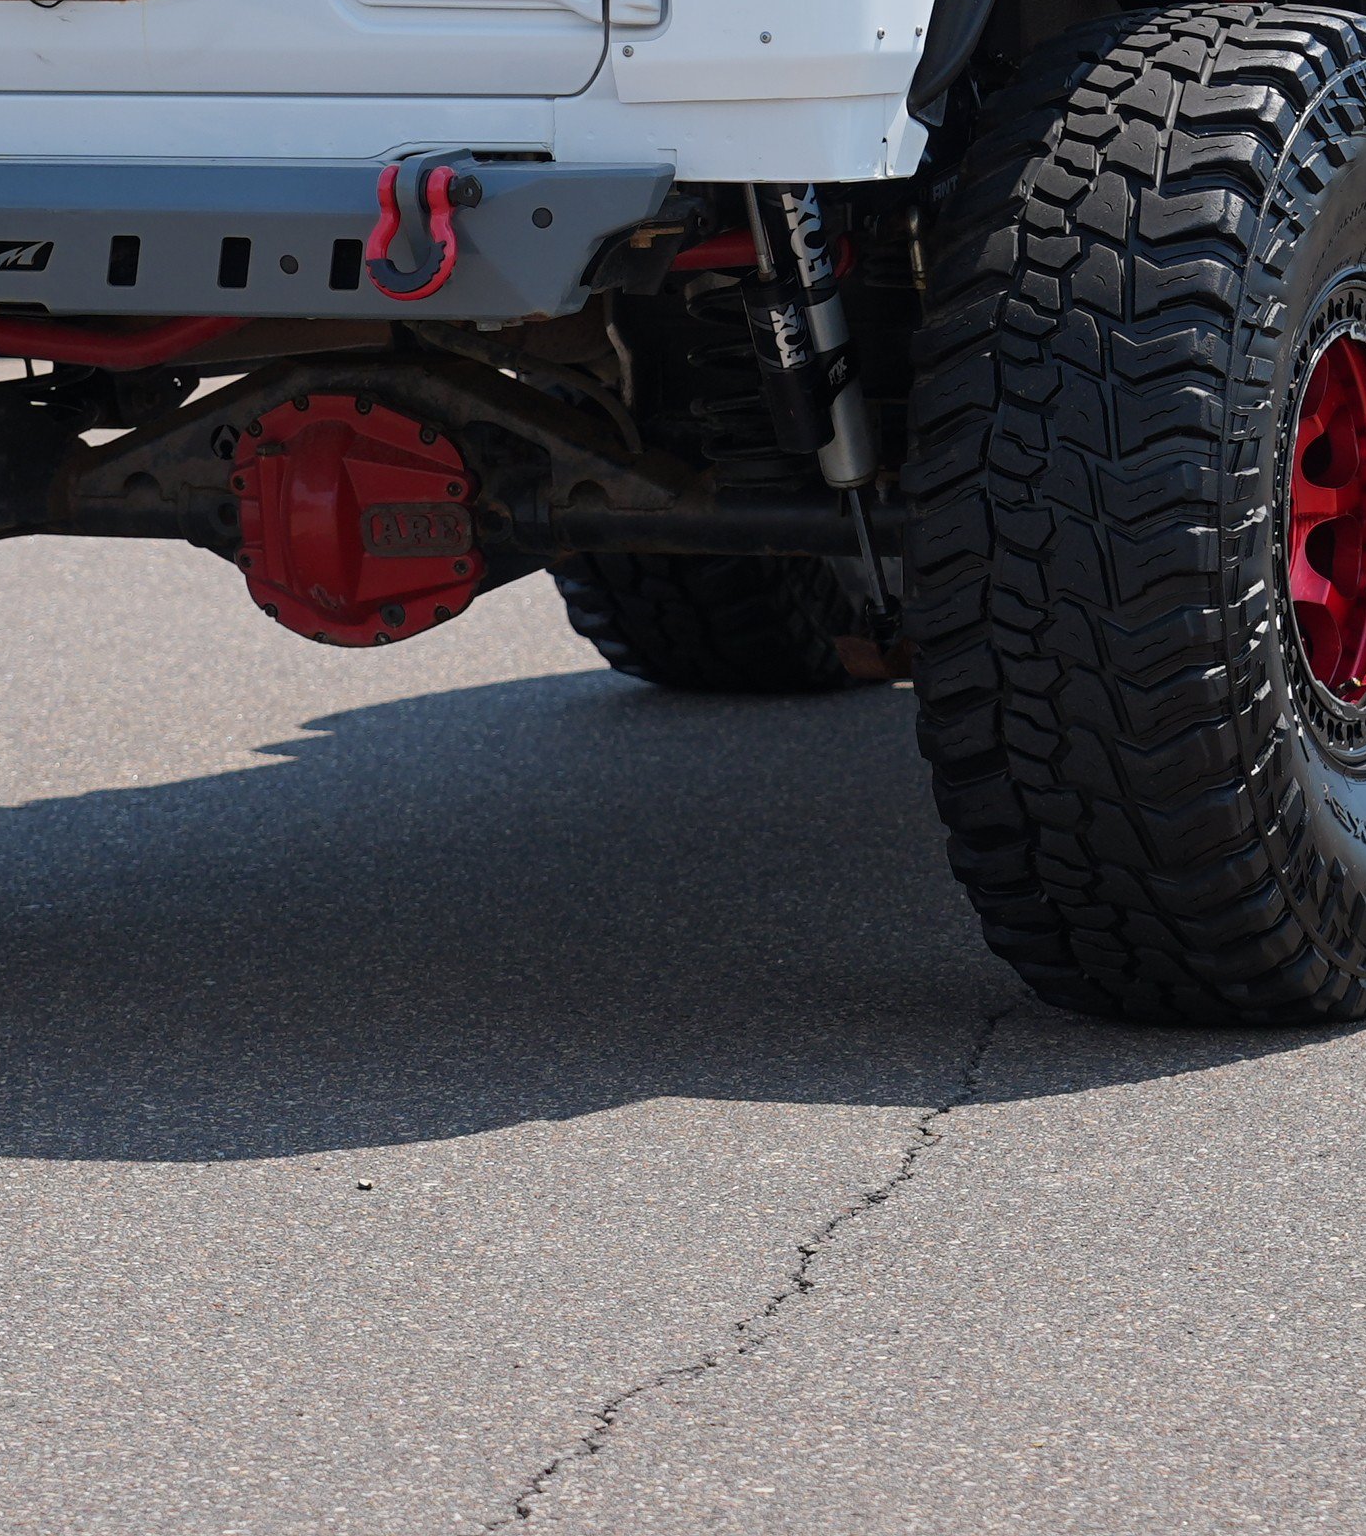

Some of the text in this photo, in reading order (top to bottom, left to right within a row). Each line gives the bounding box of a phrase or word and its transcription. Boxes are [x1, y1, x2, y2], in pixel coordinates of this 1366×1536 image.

[782, 183, 832, 288] FOX
[769, 303, 807, 369] FOX
[371, 514, 462, 547] ARB
